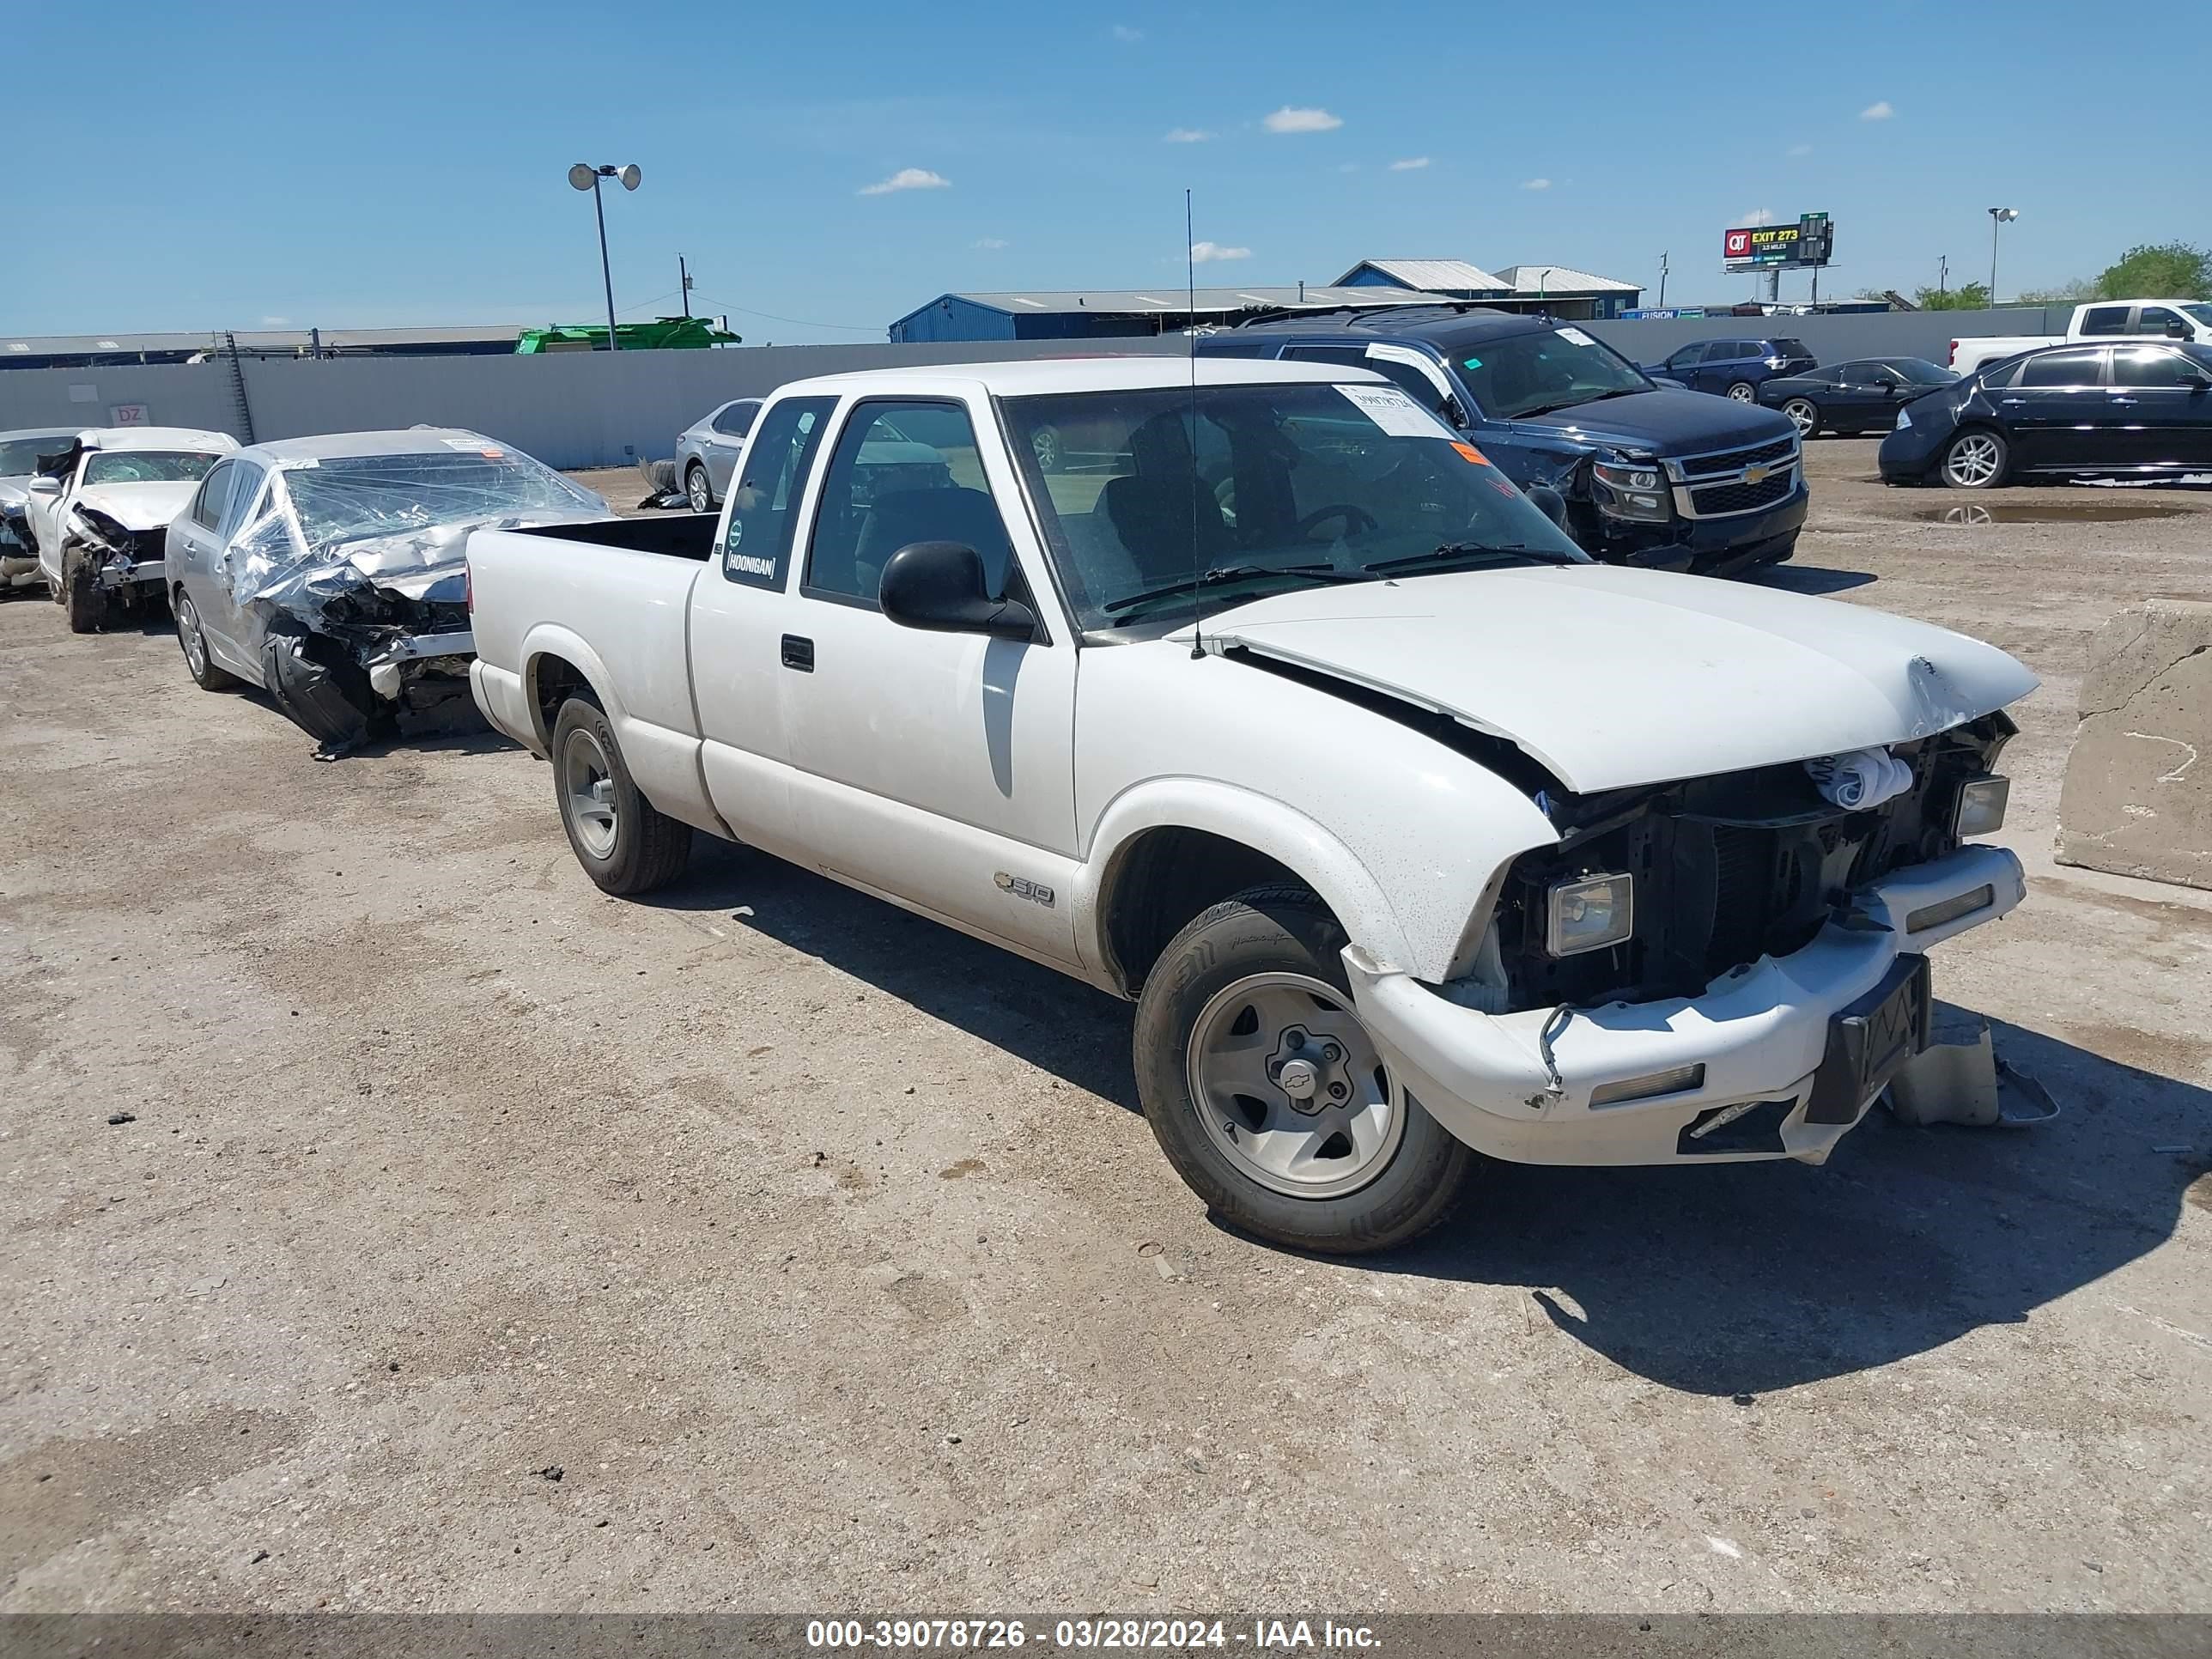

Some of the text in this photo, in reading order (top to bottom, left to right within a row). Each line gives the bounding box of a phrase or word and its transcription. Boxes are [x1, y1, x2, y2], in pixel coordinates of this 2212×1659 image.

[1729, 234, 1747, 251] QT
[1752, 232, 1776, 243] EXIT
[1778, 230, 1798, 240] 273
[118, 409, 142, 422] DZ
